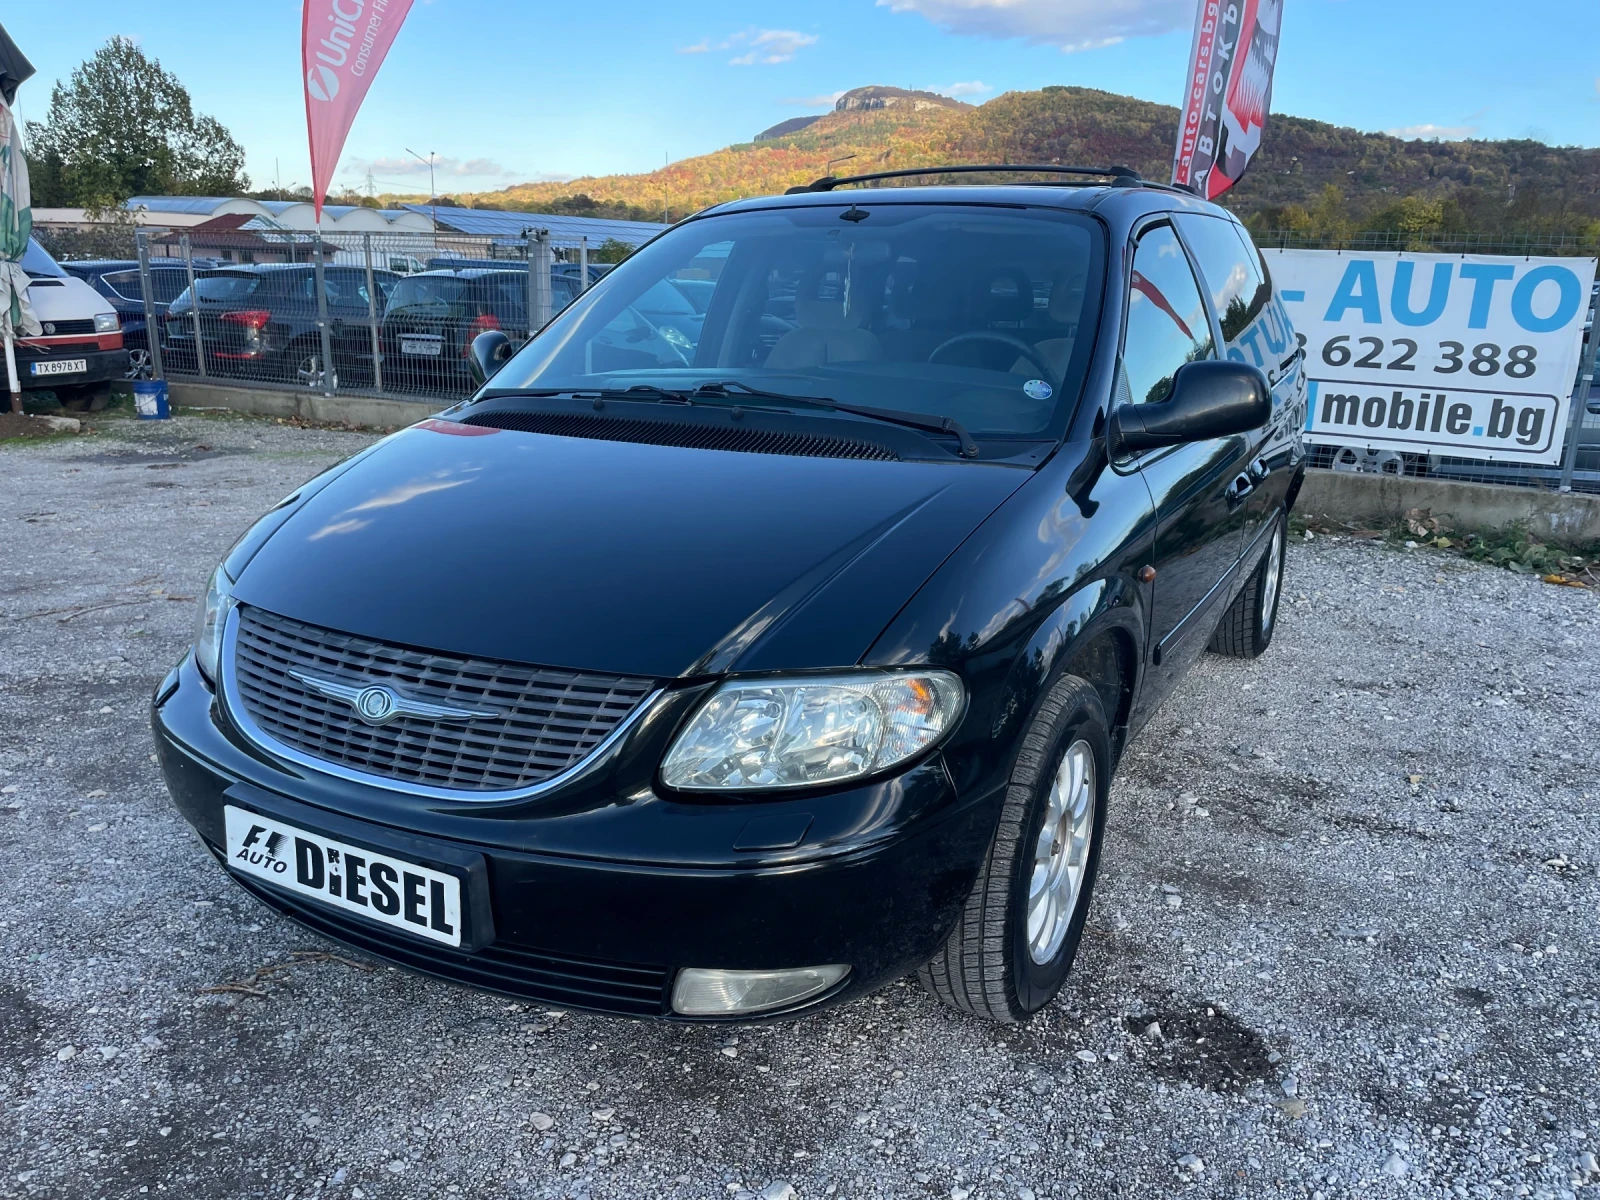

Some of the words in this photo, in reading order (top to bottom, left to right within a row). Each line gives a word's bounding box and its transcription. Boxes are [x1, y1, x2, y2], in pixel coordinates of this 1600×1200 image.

[316, 0, 365, 67] UniC
[350, 11, 382, 77] Consumer
[1323, 259, 1582, 334] AUTO
[1321, 334, 1419, 372] 622
[1433, 340, 1538, 379] 388
[1320, 390, 1546, 446] mobile.bg
[236, 848, 288, 874] AUTO
